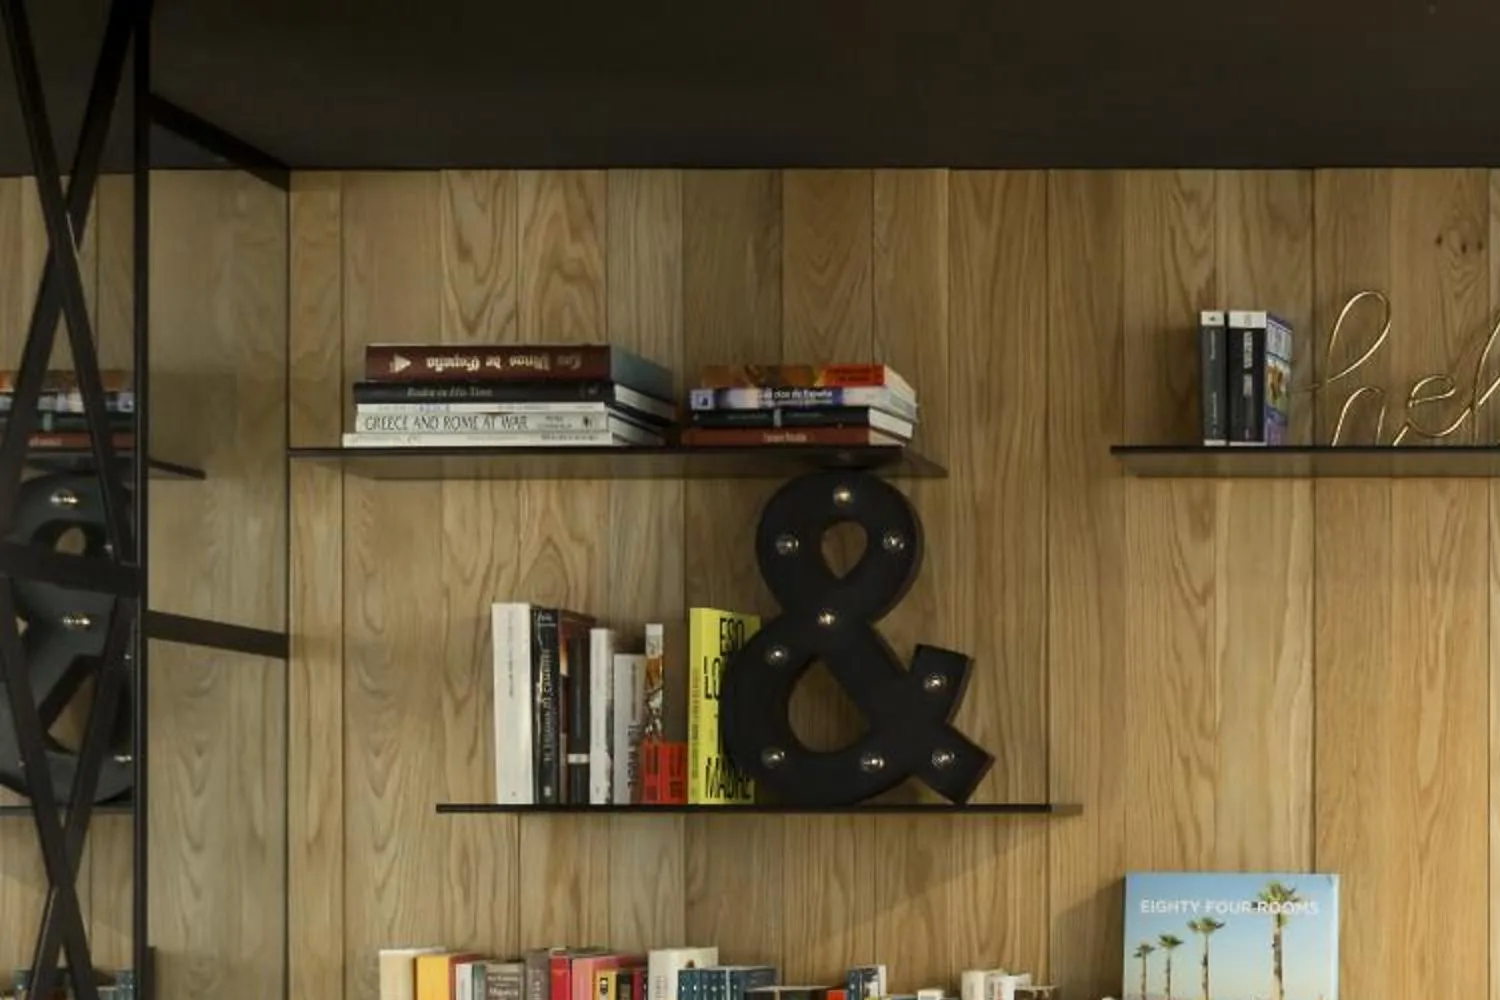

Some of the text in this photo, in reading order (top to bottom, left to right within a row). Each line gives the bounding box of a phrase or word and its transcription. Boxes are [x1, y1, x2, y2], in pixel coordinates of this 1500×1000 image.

[365, 415, 528, 430] GREECE AND ROME AT WAR
[1140, 899, 1320, 914] EIGHTY FOUR ROOMS
